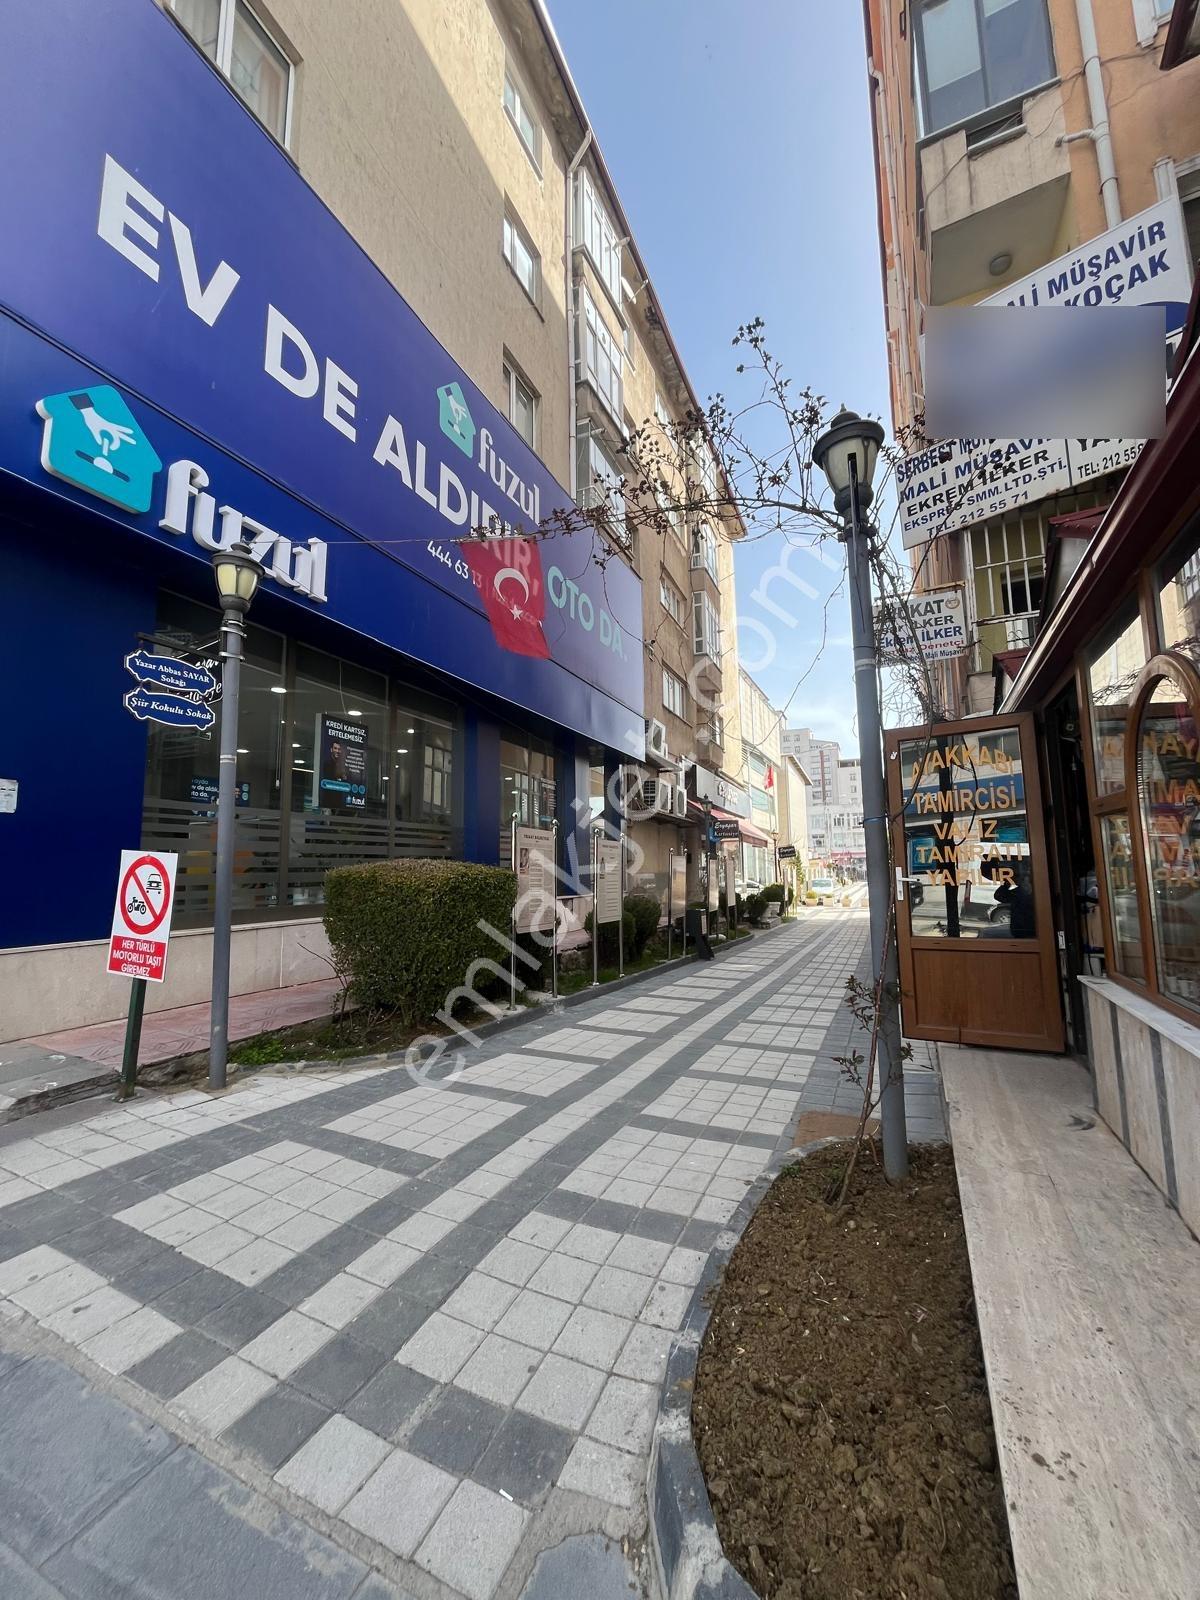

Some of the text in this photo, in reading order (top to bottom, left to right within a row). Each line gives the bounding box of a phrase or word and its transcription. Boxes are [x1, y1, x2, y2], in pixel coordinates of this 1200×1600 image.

[1047, 221, 1167, 299] MÜŞAVİR
[97, 153, 241, 326] EV
[264, 303, 359, 442] DE
[547, 565, 595, 631] OTO
[479, 426, 540, 525] fuzul
[900, 468, 947, 503] MALİ
[955, 439, 1052, 480] MÜŞAV
[1077, 461, 1100, 478] TEL:
[1102, 452, 1121, 470] 212
[906, 478, 975, 517] EKREM
[960, 508, 985, 525] 212
[989, 499, 1007, 513] 55
[1011, 490, 1029, 505] 71
[158, 458, 328, 603] fuzul
[427, 540, 452, 568] 444
[454, 559, 469, 579] 63
[911, 614, 955, 630] LKER
[921, 626, 963, 642] İLKER
[134, 658, 210, 683] Yazar Abbas SAYAR
[160, 674, 186, 687] Sokağı
[130, 697, 212, 720] Şiir Kokulu Sokak
[326, 719, 343, 730] KREDİ
[915, 780, 1017, 814] TAMİRCİSİ
[926, 867, 1017, 886] YAPILIR
[112, 949, 162, 968] MOTORLU TAŞIT
[122, 939, 155, 953] HER TÜRLÜ
[121, 962, 150, 976] GİREMEZ
